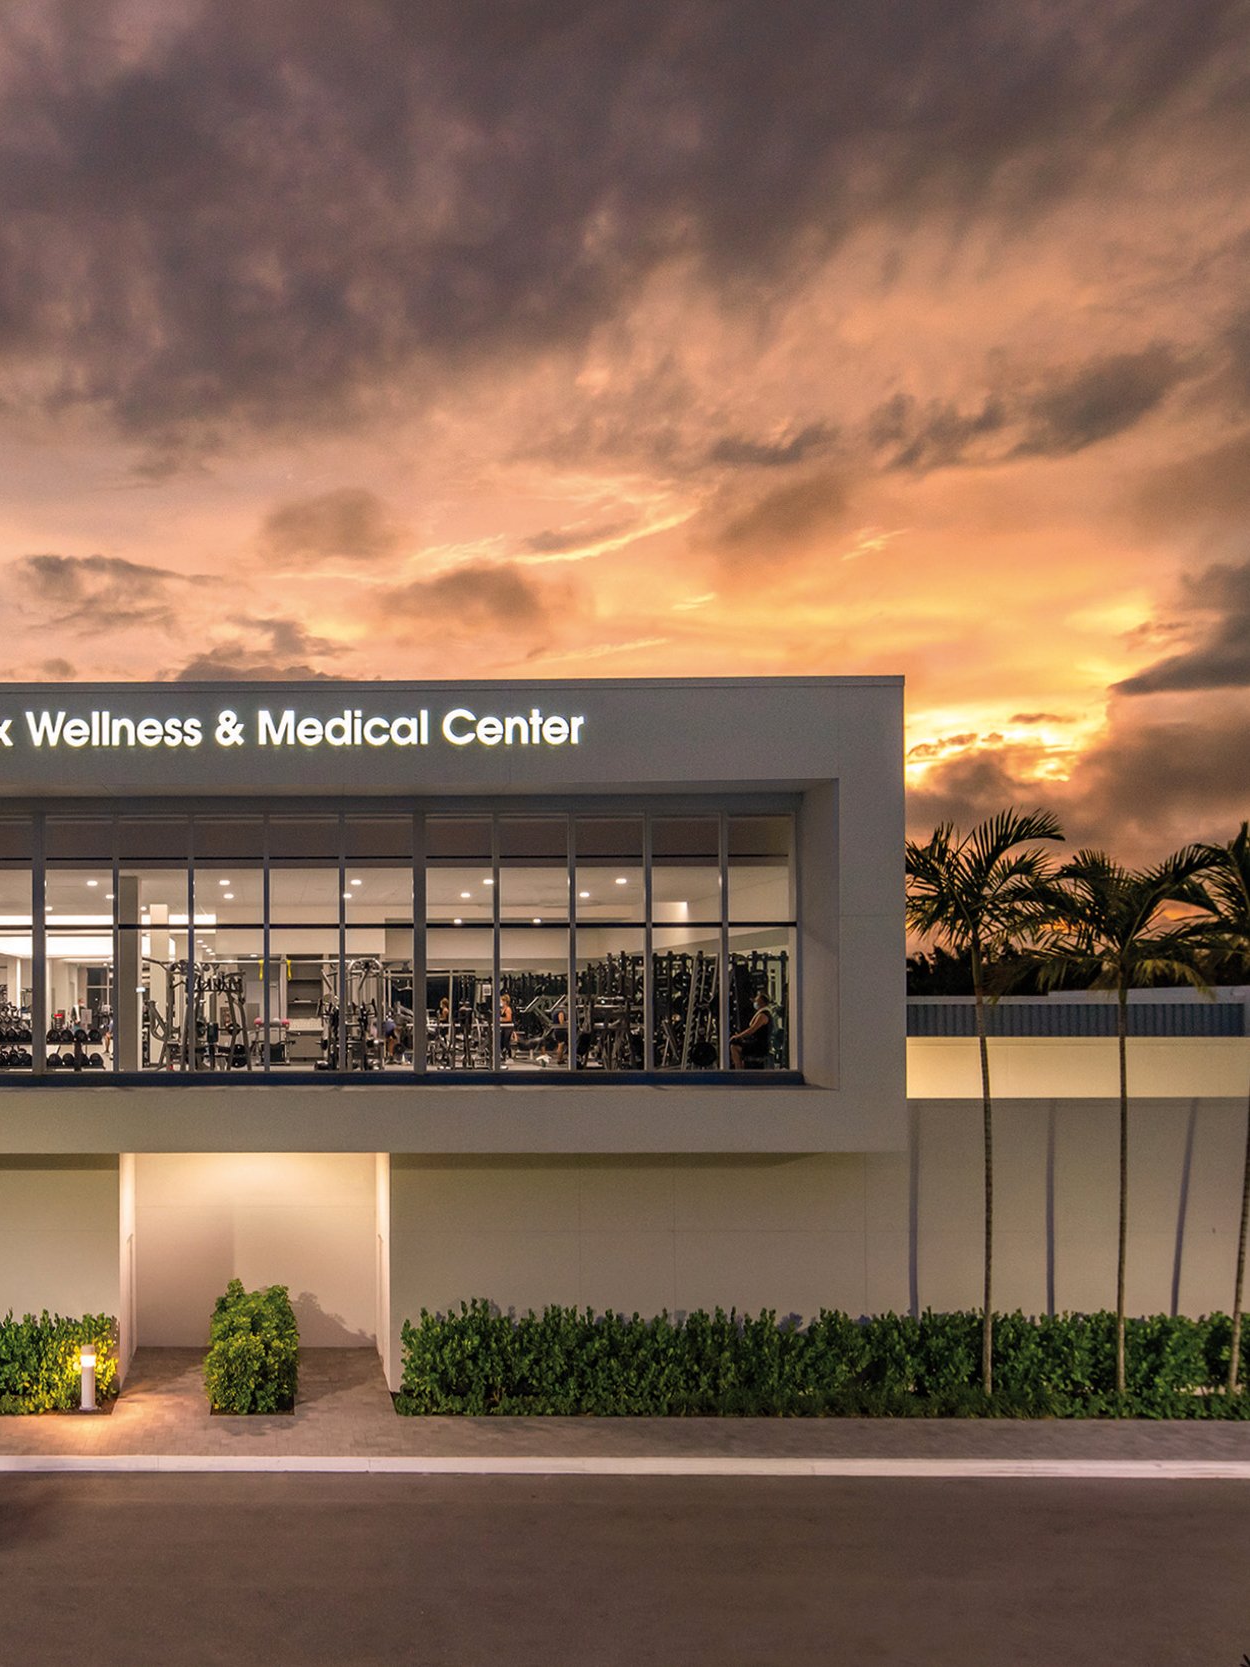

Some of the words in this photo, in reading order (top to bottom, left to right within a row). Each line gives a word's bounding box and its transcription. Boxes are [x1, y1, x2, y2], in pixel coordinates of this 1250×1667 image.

[25, 710, 203, 747] Wellness
[215, 709, 245, 747] &
[258, 709, 428, 746] Medical
[443, 708, 584, 745] Center
